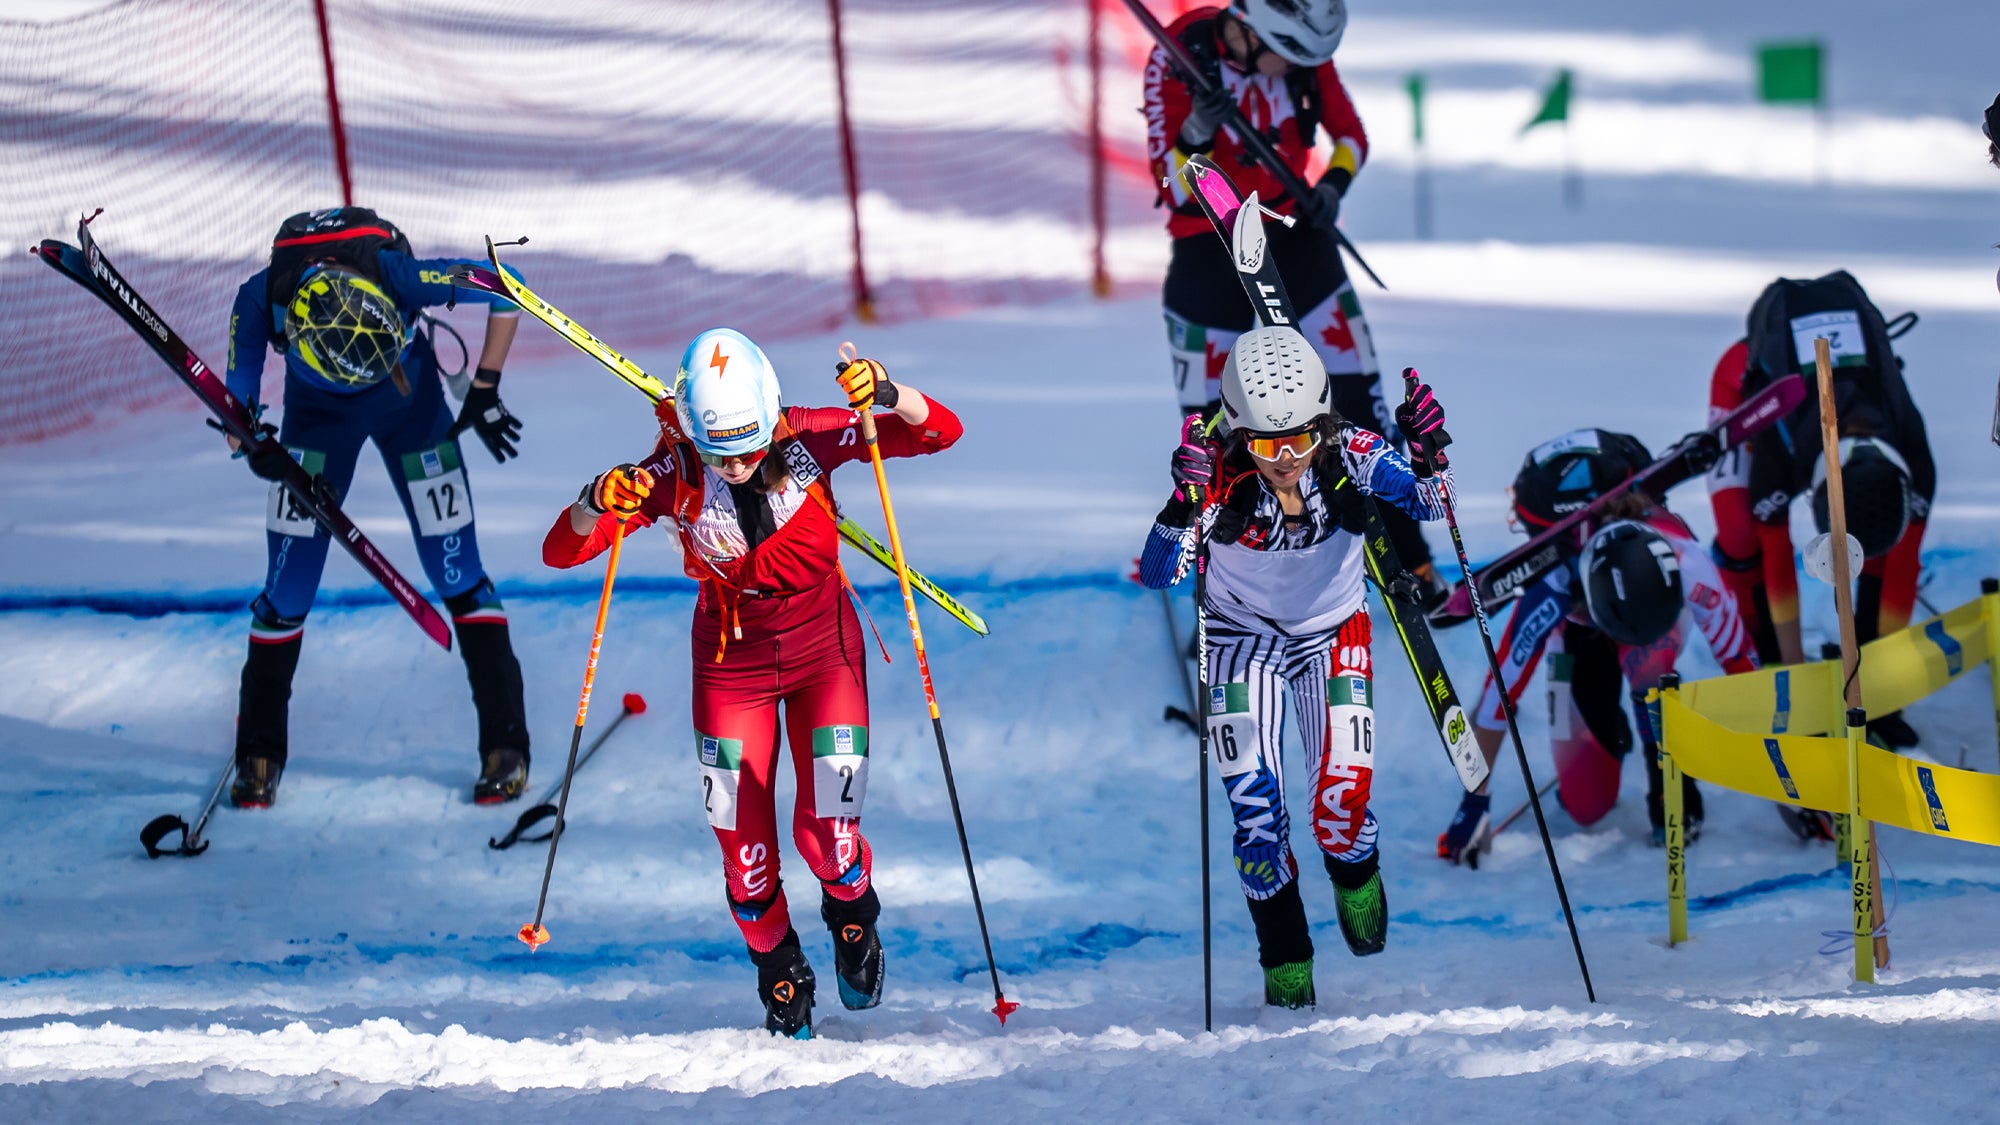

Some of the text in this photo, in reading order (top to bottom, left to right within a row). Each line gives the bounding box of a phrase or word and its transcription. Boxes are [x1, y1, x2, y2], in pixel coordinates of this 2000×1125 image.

[1145, 50, 1170, 159] CANADA
[427, 483, 459, 521] 12
[1198, 606, 1207, 684] DYNAFIT
[1511, 600, 1558, 667] CRAZY
[1210, 724, 1238, 763] 16
[1350, 715, 1372, 754] 16
[1447, 710, 1466, 745] 64
[703, 775, 713, 813] 2
[838, 765, 854, 803] 2
[1668, 814, 1678, 893] LISKI
[1853, 850, 1864, 930] LISKI
